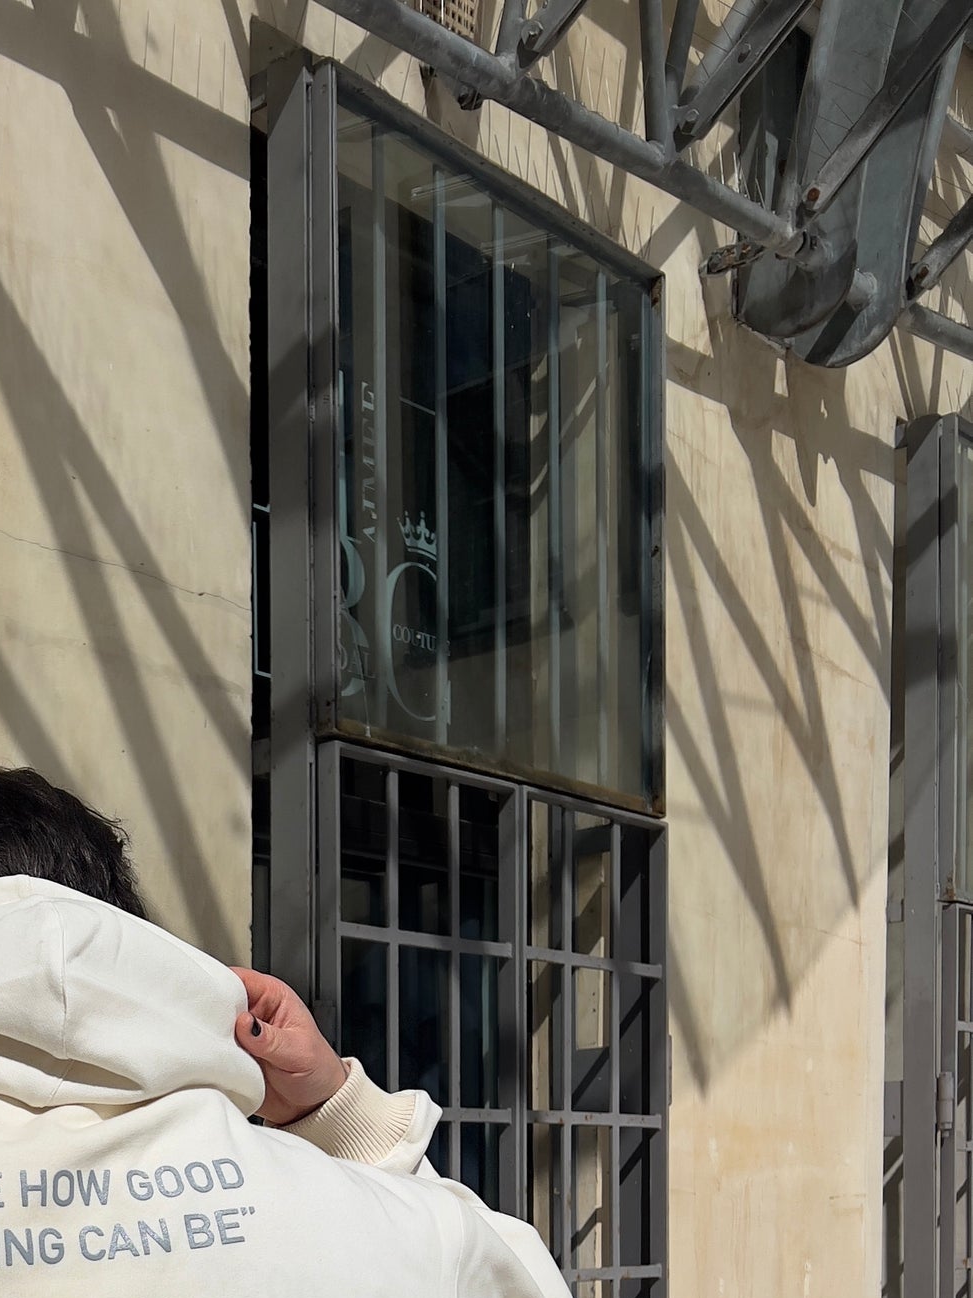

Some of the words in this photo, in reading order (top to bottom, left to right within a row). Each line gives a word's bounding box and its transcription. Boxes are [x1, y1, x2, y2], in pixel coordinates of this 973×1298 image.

[20, 1169, 111, 1208] HOW
[126, 1158, 245, 1201] GOOD
[78, 1217, 173, 1262] CAN
[184, 1206, 256, 1251] BE”
